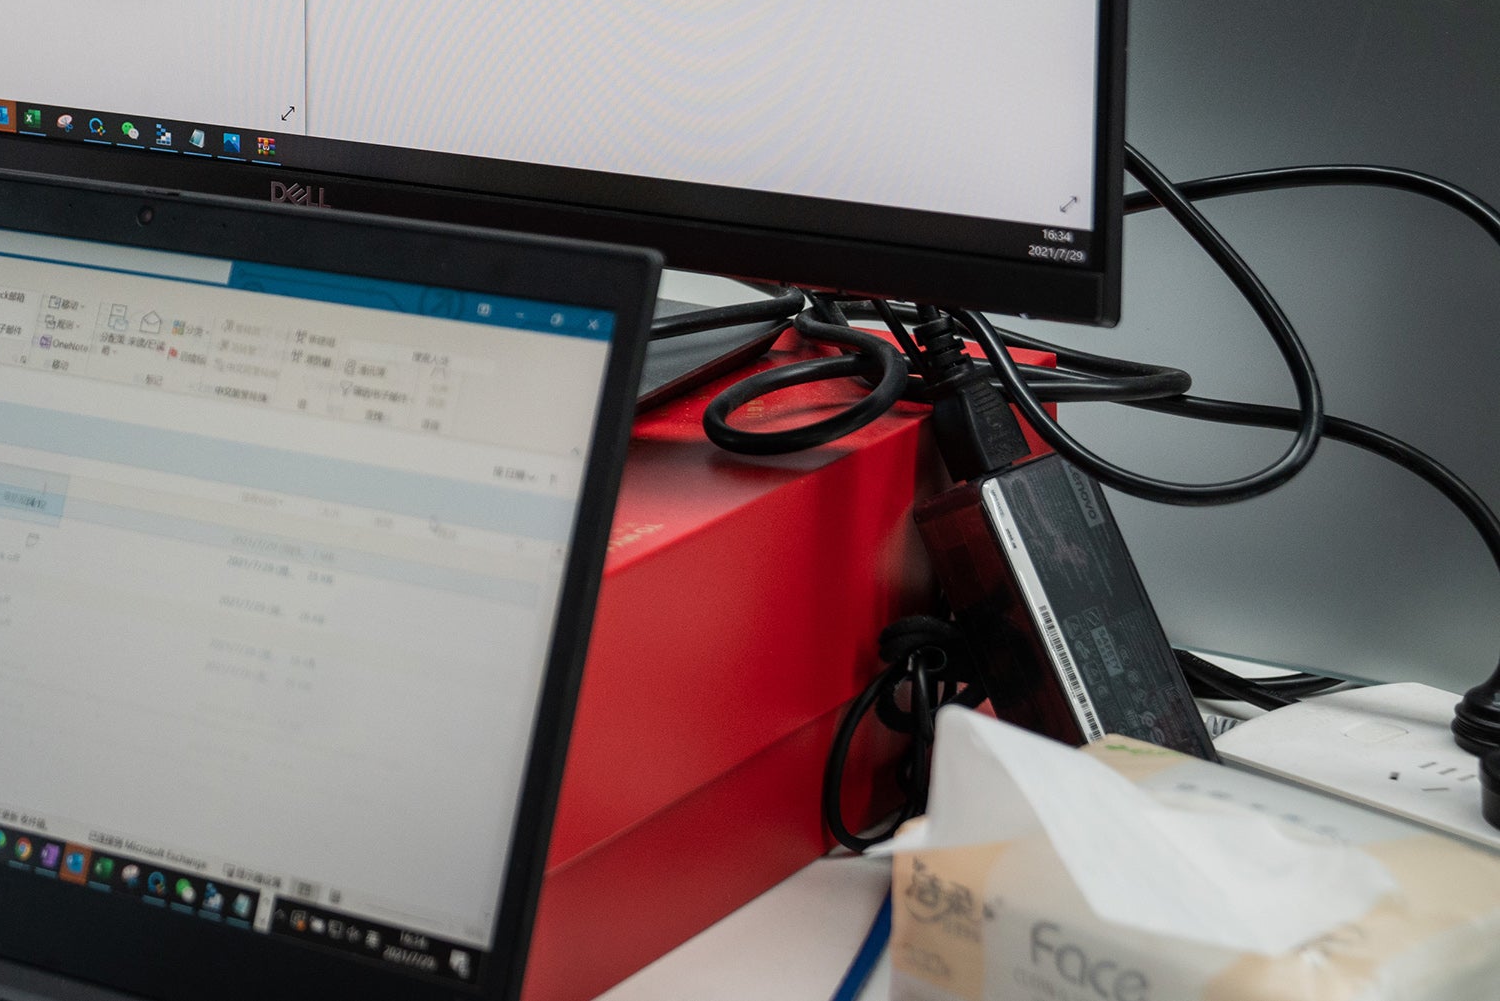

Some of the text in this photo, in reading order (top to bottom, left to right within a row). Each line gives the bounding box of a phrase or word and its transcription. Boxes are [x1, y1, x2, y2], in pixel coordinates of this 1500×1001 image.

[270, 181, 332, 209] DELL
[1041, 229, 1072, 243] 16:34
[1028, 244, 1084, 262] 2021/7/29
[1030, 920, 1151, 1001] Face
